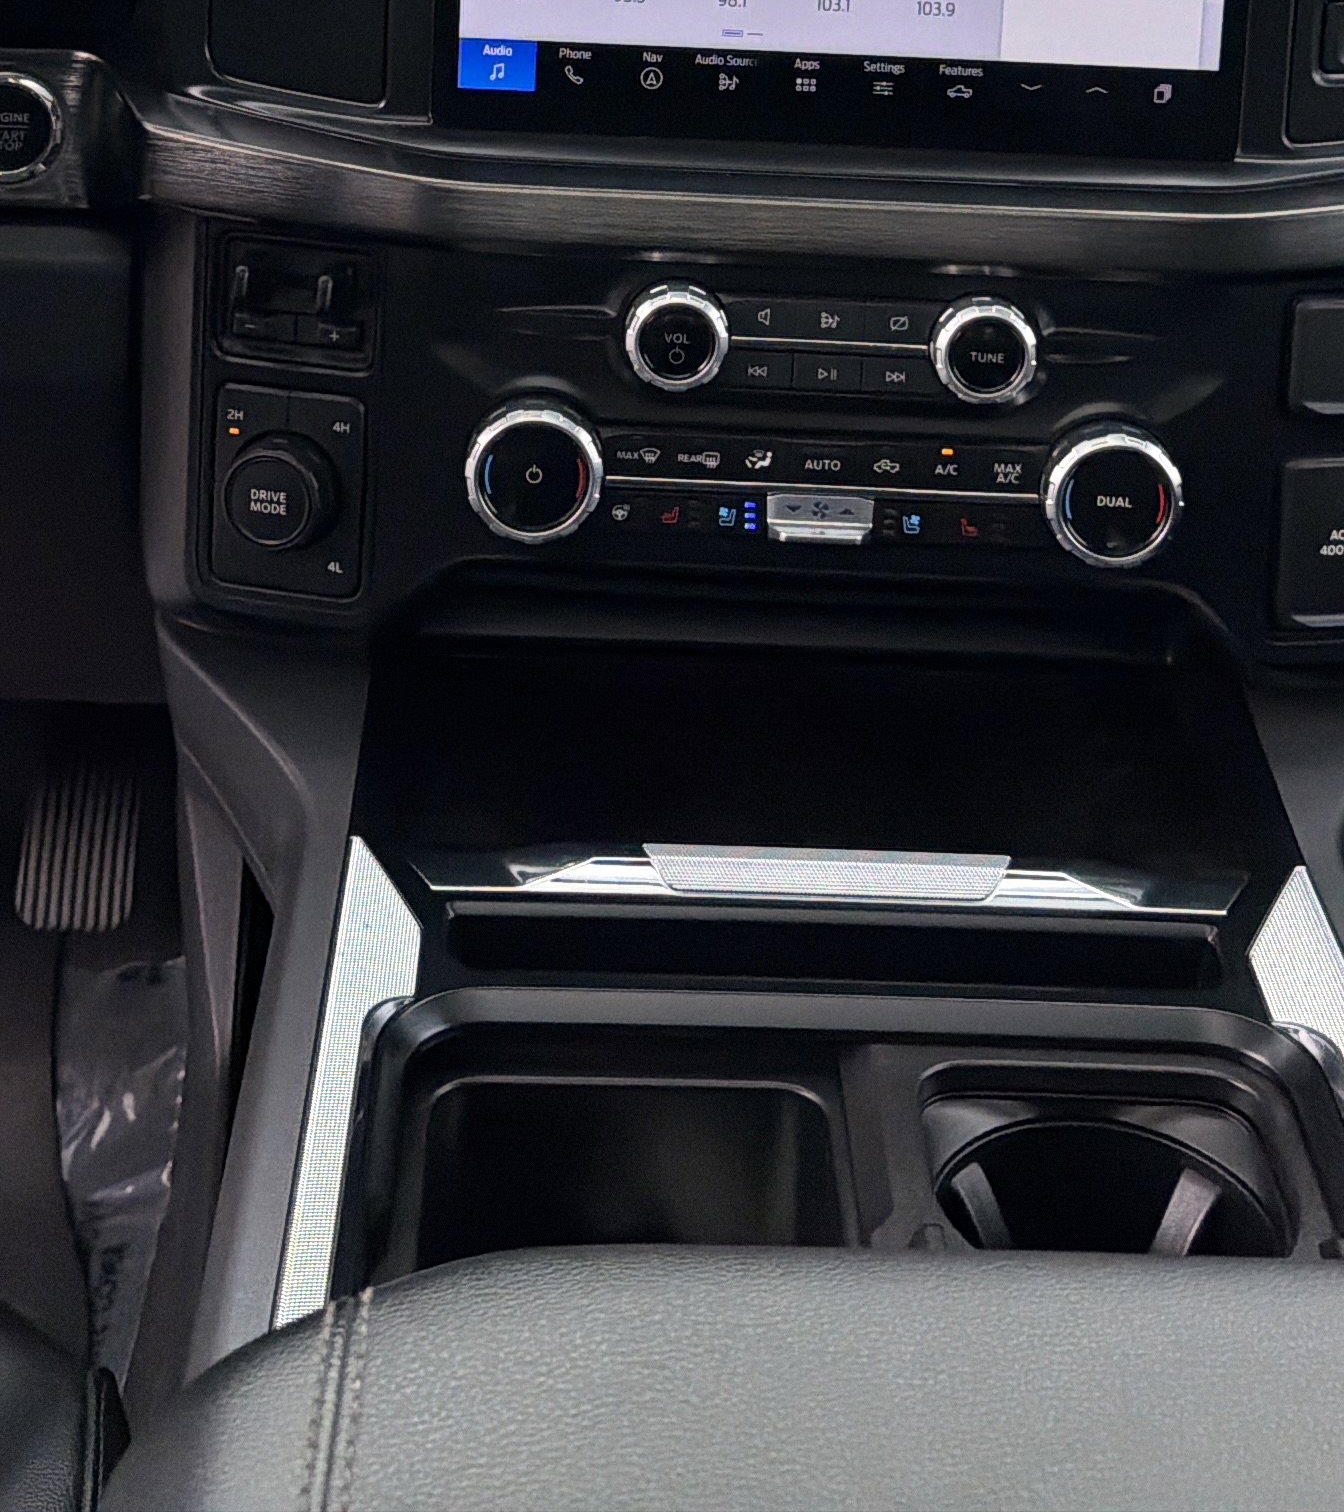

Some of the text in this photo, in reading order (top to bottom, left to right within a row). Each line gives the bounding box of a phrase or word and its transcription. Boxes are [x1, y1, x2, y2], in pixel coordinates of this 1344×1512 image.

[916, 0, 956, 18] 103.9
[482, 44, 513, 58] Audio
[558, 47, 592, 62] Phone
[643, 51, 664, 65] Nav
[695, 53, 724, 67] Audio
[794, 58, 820, 72] Apps
[863, 60, 905, 76] Settings
[939, 63, 984, 78] Features
[664, 331, 690, 346] VOL
[969, 351, 1005, 365] TUNE
[226, 408, 244, 420] 2H
[332, 421, 351, 434] 4H
[616, 451, 639, 461] MAX
[677, 453, 703, 465] REAR
[804, 459, 841, 472] AUTO
[934, 464, 959, 477] A/C
[994, 463, 1022, 475] MAX
[995, 473, 1020, 485] A/C
[250, 489, 287, 503] DRIVE
[1096, 495, 1133, 509] DUAL
[250, 501, 287, 515] MODE
[327, 561, 344, 574] 4L
